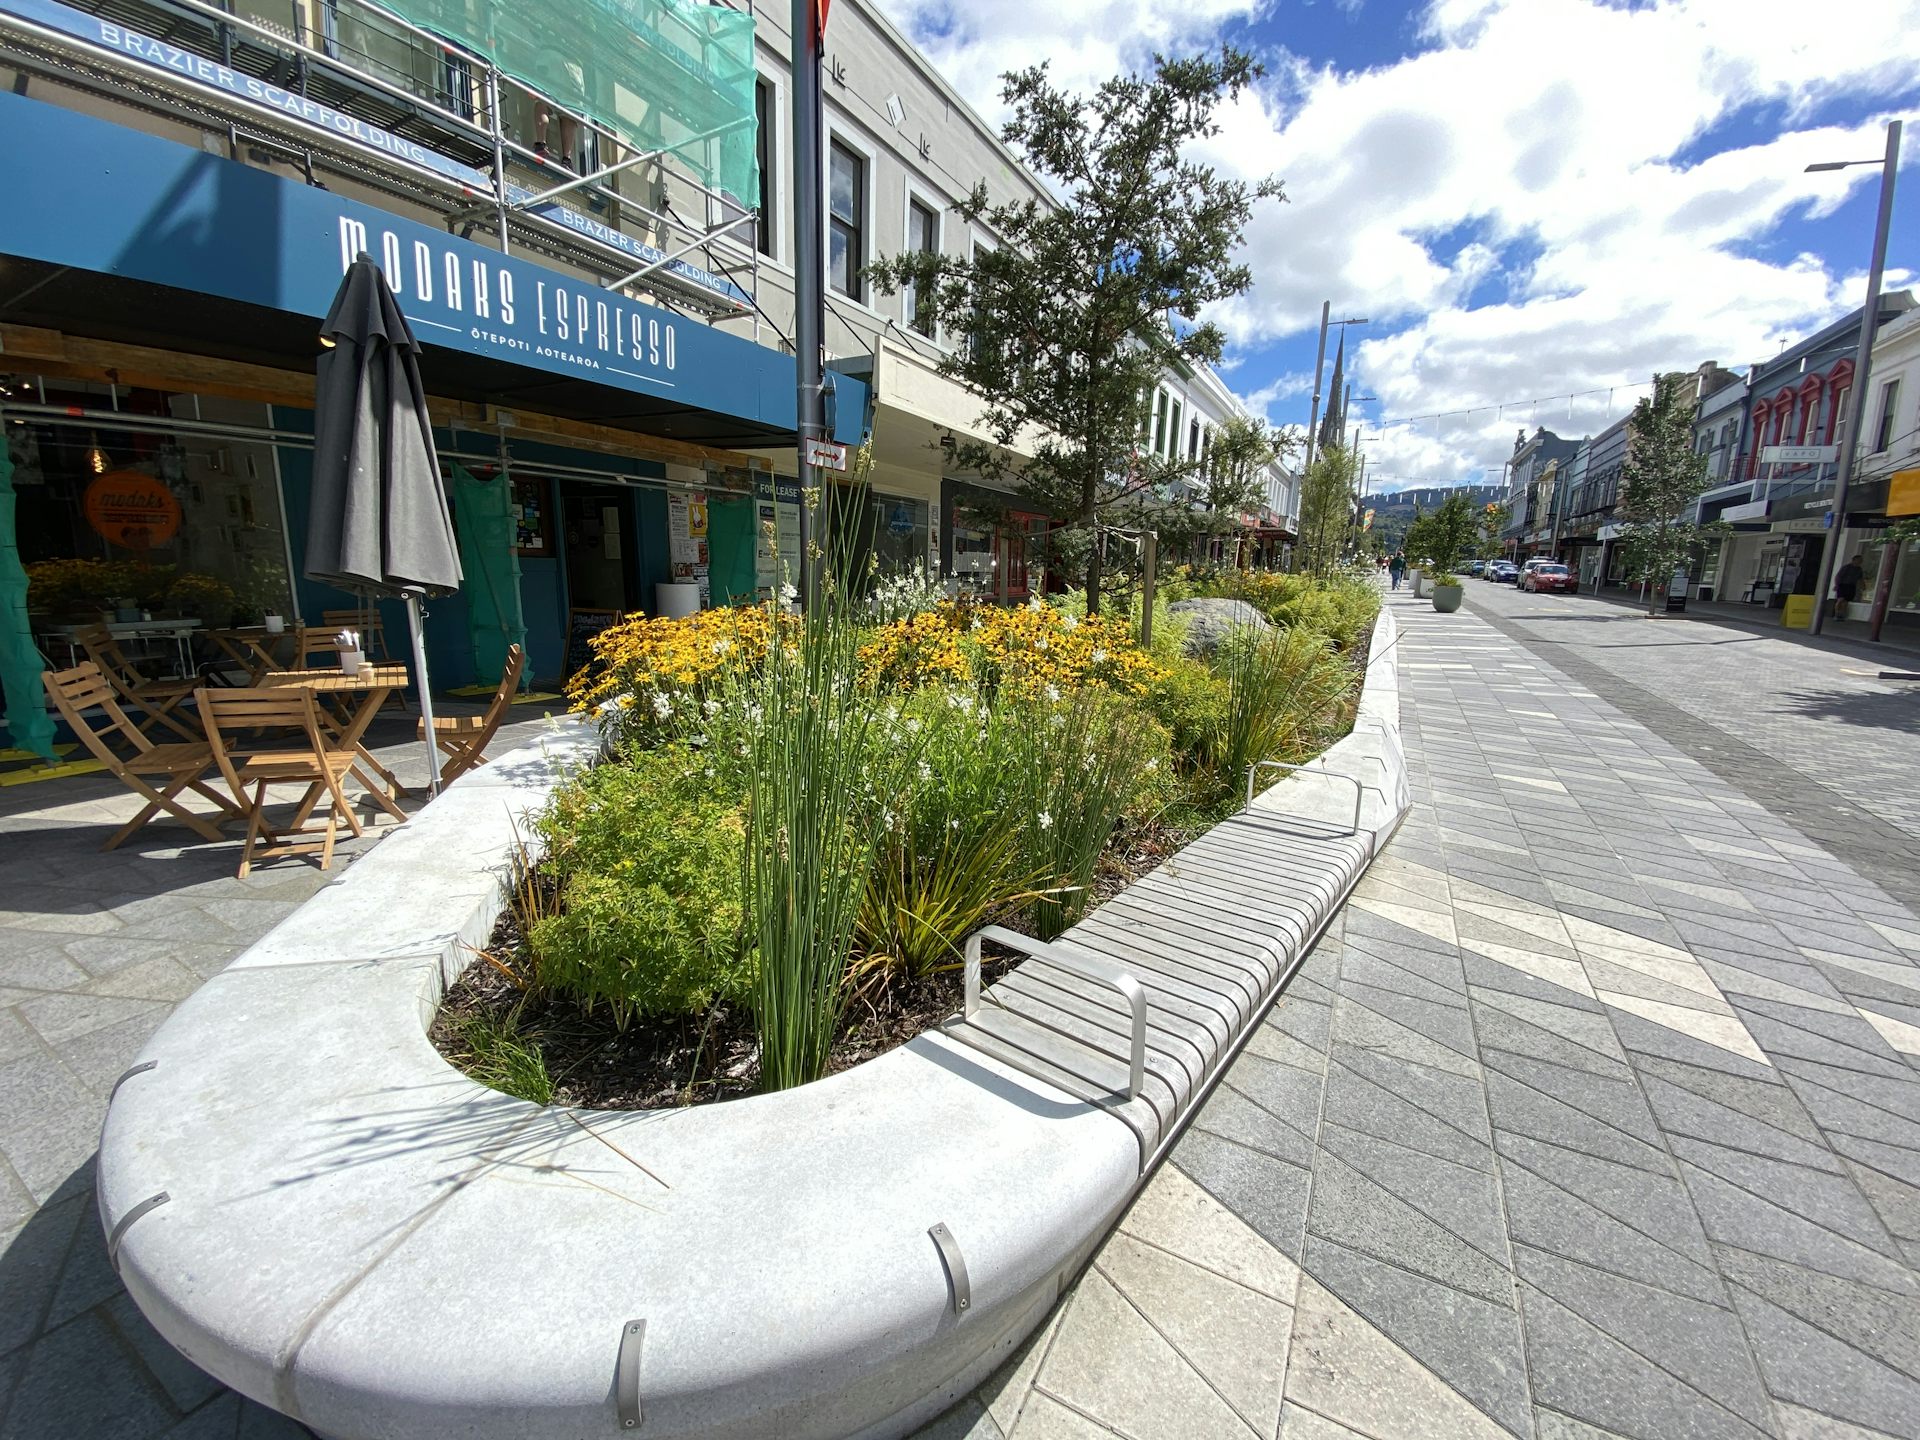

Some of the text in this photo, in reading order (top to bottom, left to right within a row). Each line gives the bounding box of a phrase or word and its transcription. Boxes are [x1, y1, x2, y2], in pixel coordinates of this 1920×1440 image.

[101, 22, 426, 163] BRAZIER SCAFFOLDING
[562, 209, 629, 249] BRAZIER
[537, 281, 675, 370] ESPRESSO
[470, 327, 600, 370] ŌTEPOTI AOTEAROA
[760, 483, 775, 495] FOR
